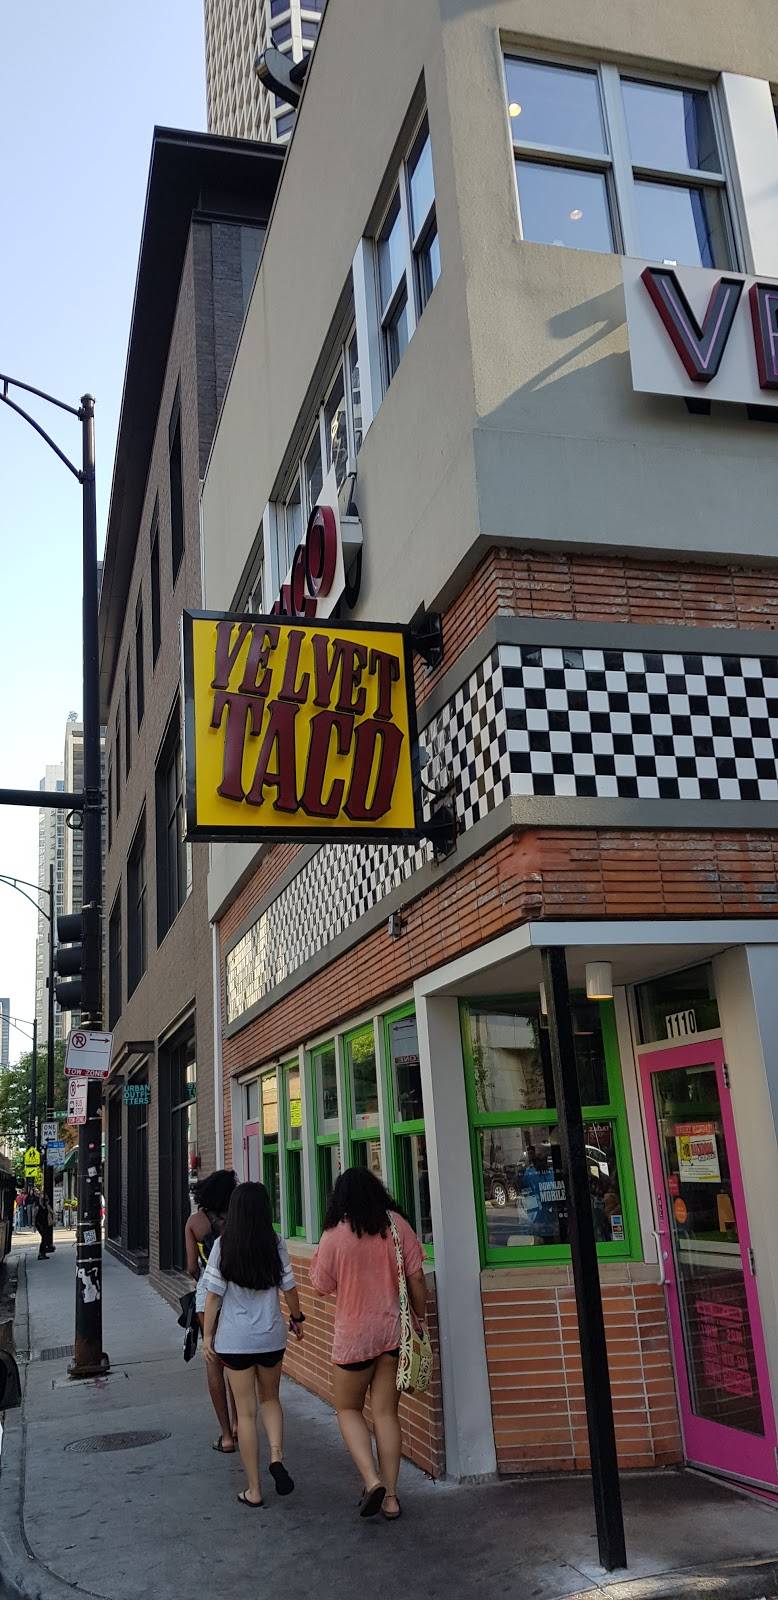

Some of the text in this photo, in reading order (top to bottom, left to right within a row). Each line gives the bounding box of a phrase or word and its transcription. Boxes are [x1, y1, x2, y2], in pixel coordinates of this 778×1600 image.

[211, 622, 400, 720] VELVET
[209, 691, 405, 822] TACO
[668, 1011, 696, 1038] 1110
[67, 1068, 105, 1077] TOW ZONE
[124, 1084, 150, 1092] URBAN
[540, 1189, 567, 1202] MOBILE
